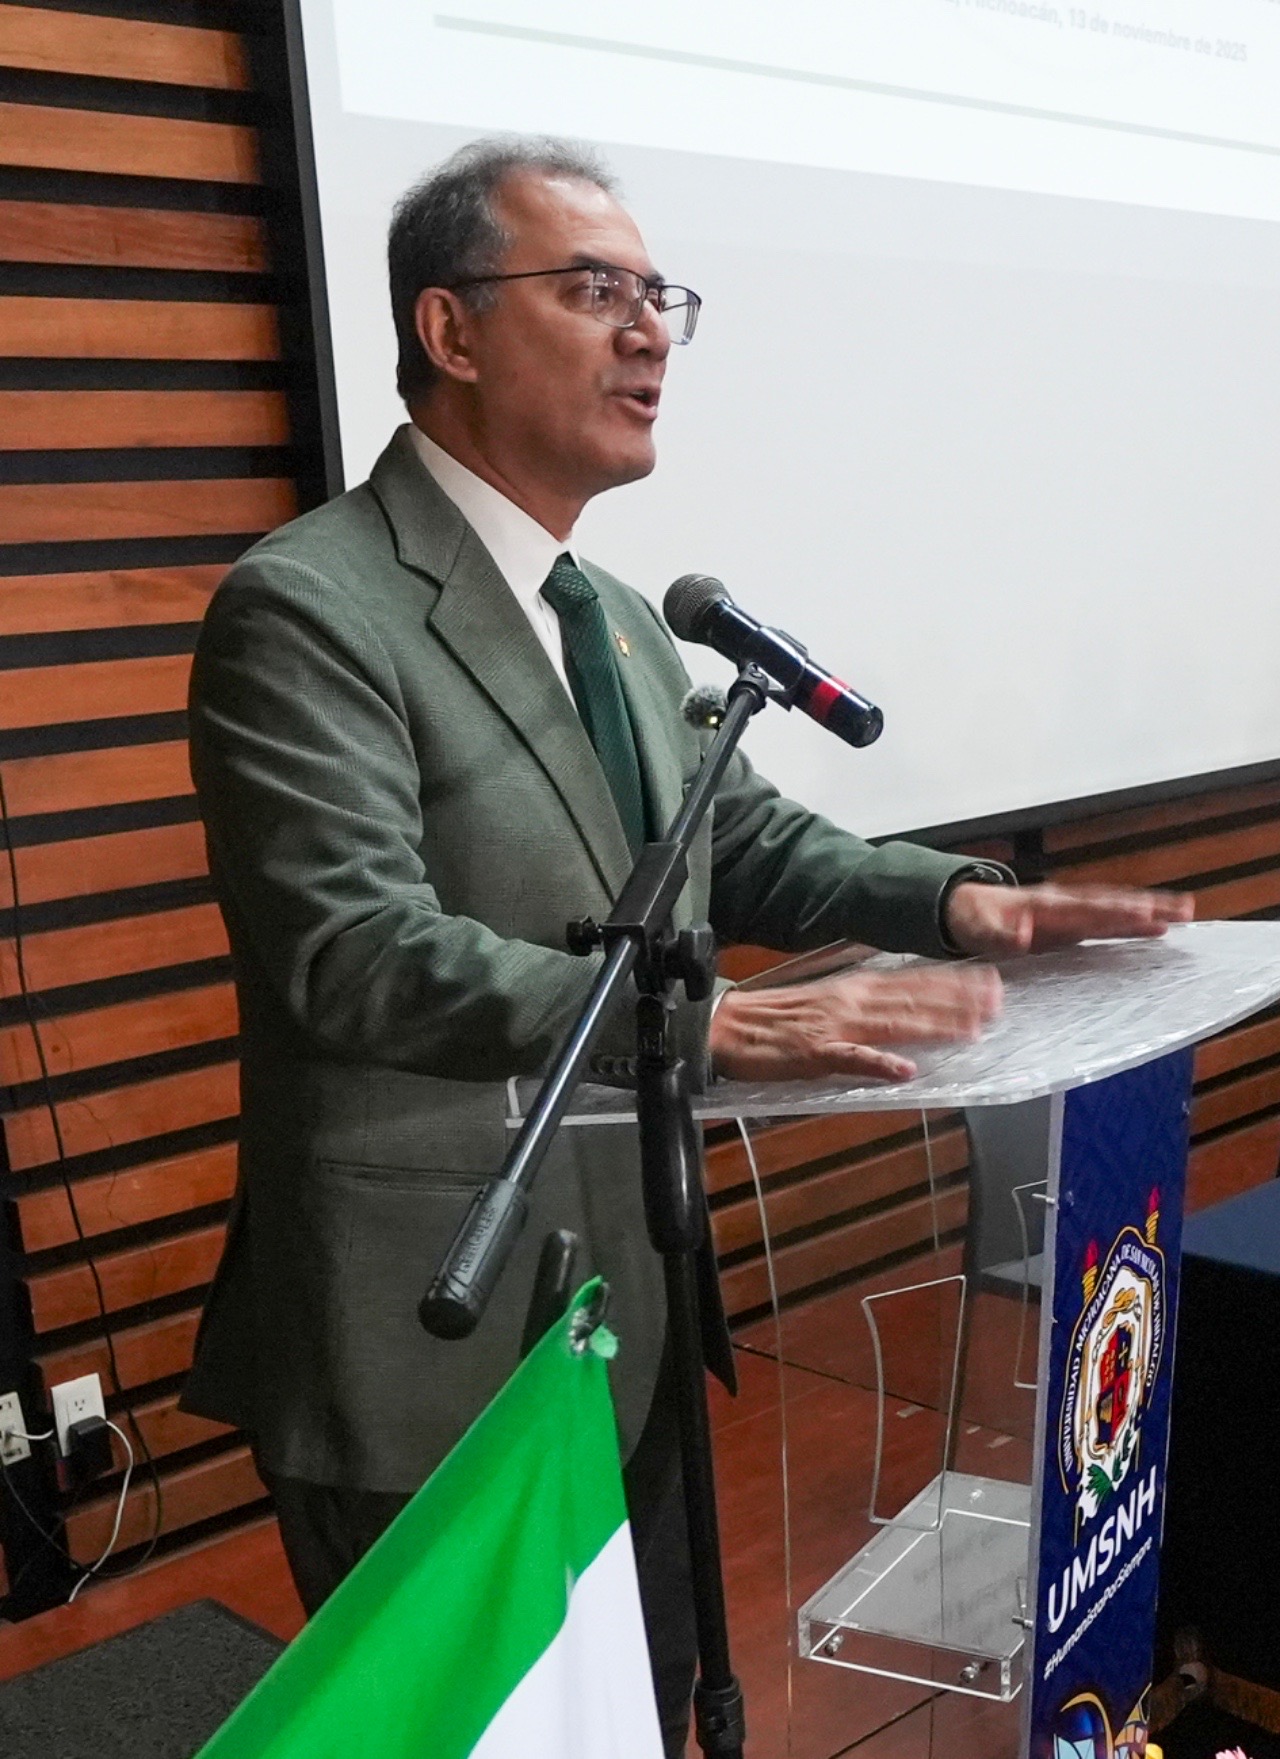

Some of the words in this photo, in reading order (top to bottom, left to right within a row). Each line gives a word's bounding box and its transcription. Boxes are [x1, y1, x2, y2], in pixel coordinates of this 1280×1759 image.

[1069, 8, 1086, 29] 13
[1089, 12, 1109, 34] de
[1112, 21, 1191, 51] noviembre
[1194, 35, 1212, 55] de
[1214, 37, 1248, 62] 2025
[1043, 1536, 1153, 1681] #HumanistaPorSiempre
[1048, 1465, 1157, 1633] UMSNH
